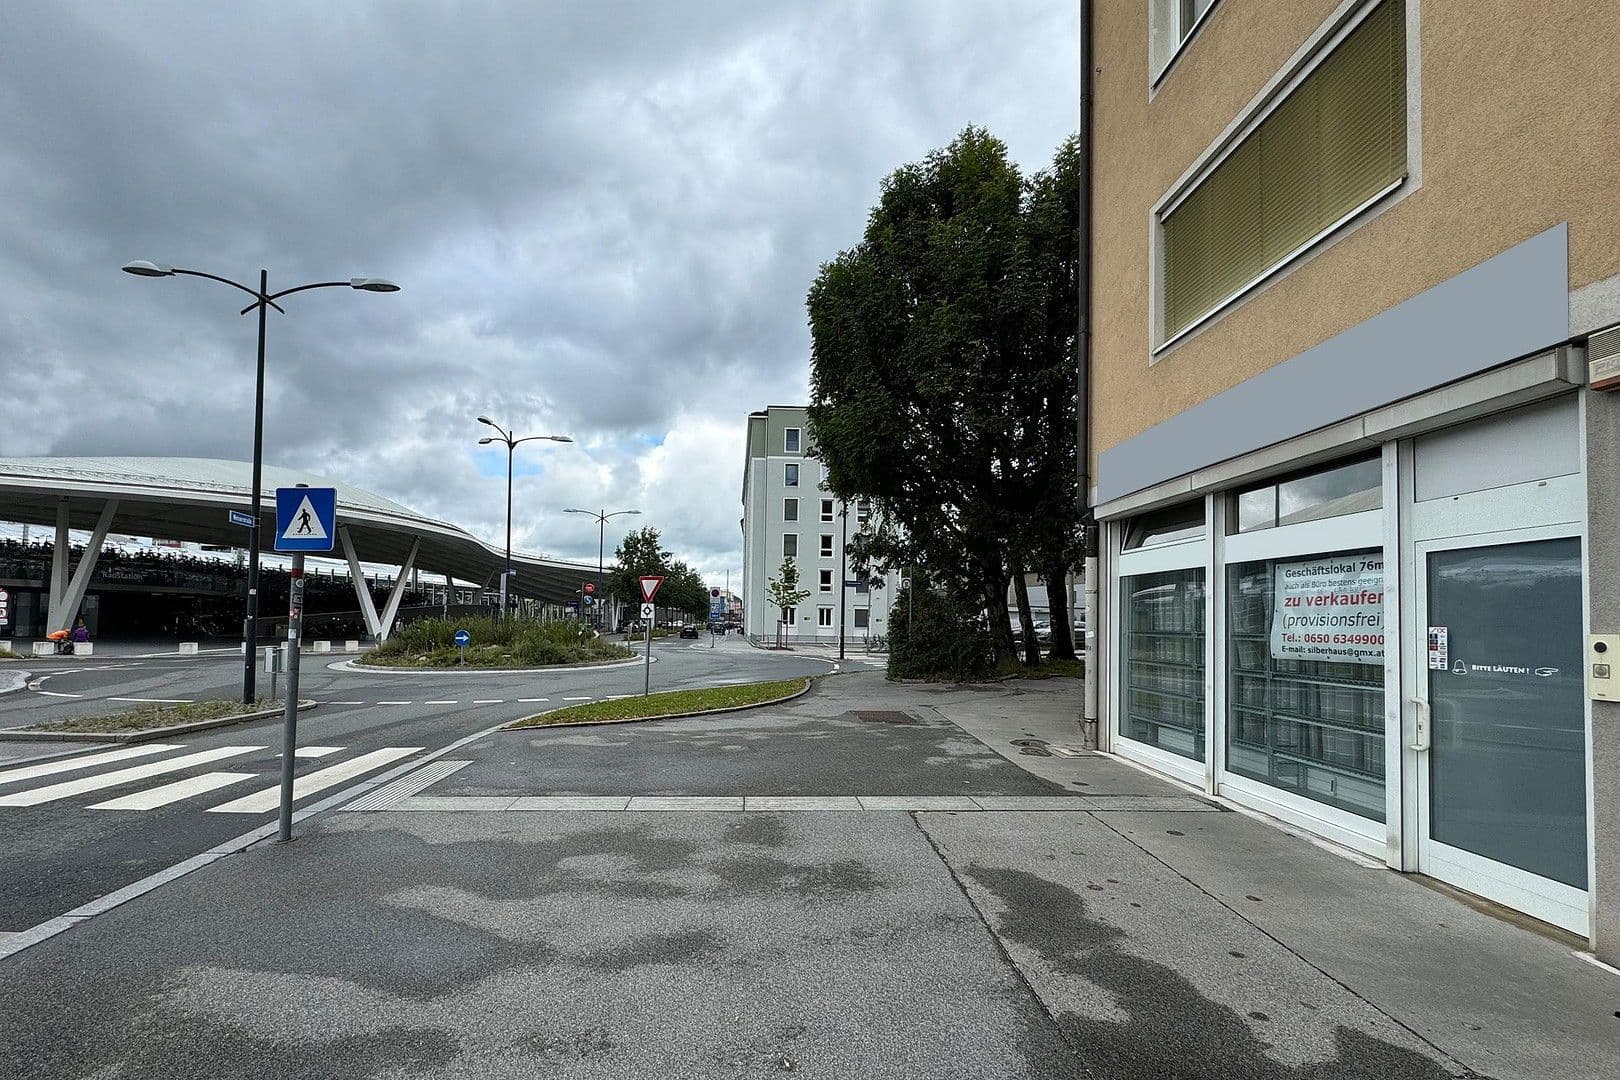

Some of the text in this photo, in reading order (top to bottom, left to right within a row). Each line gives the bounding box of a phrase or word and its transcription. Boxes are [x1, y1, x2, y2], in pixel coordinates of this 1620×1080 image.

[1285, 562, 1356, 578] Geschäftslokal
[1284, 581, 1300, 590] auch
[1301, 580, 1310, 589] als
[1328, 578, 1356, 587] bestens
[1284, 597, 1301, 607] zu
[1281, 633, 1384, 645] Tel.: 0650 6349900
[1281, 645, 1384, 658] E-mail: silberhaus@gmx.at
[1492, 664, 1525, 673] LÄUTEN
